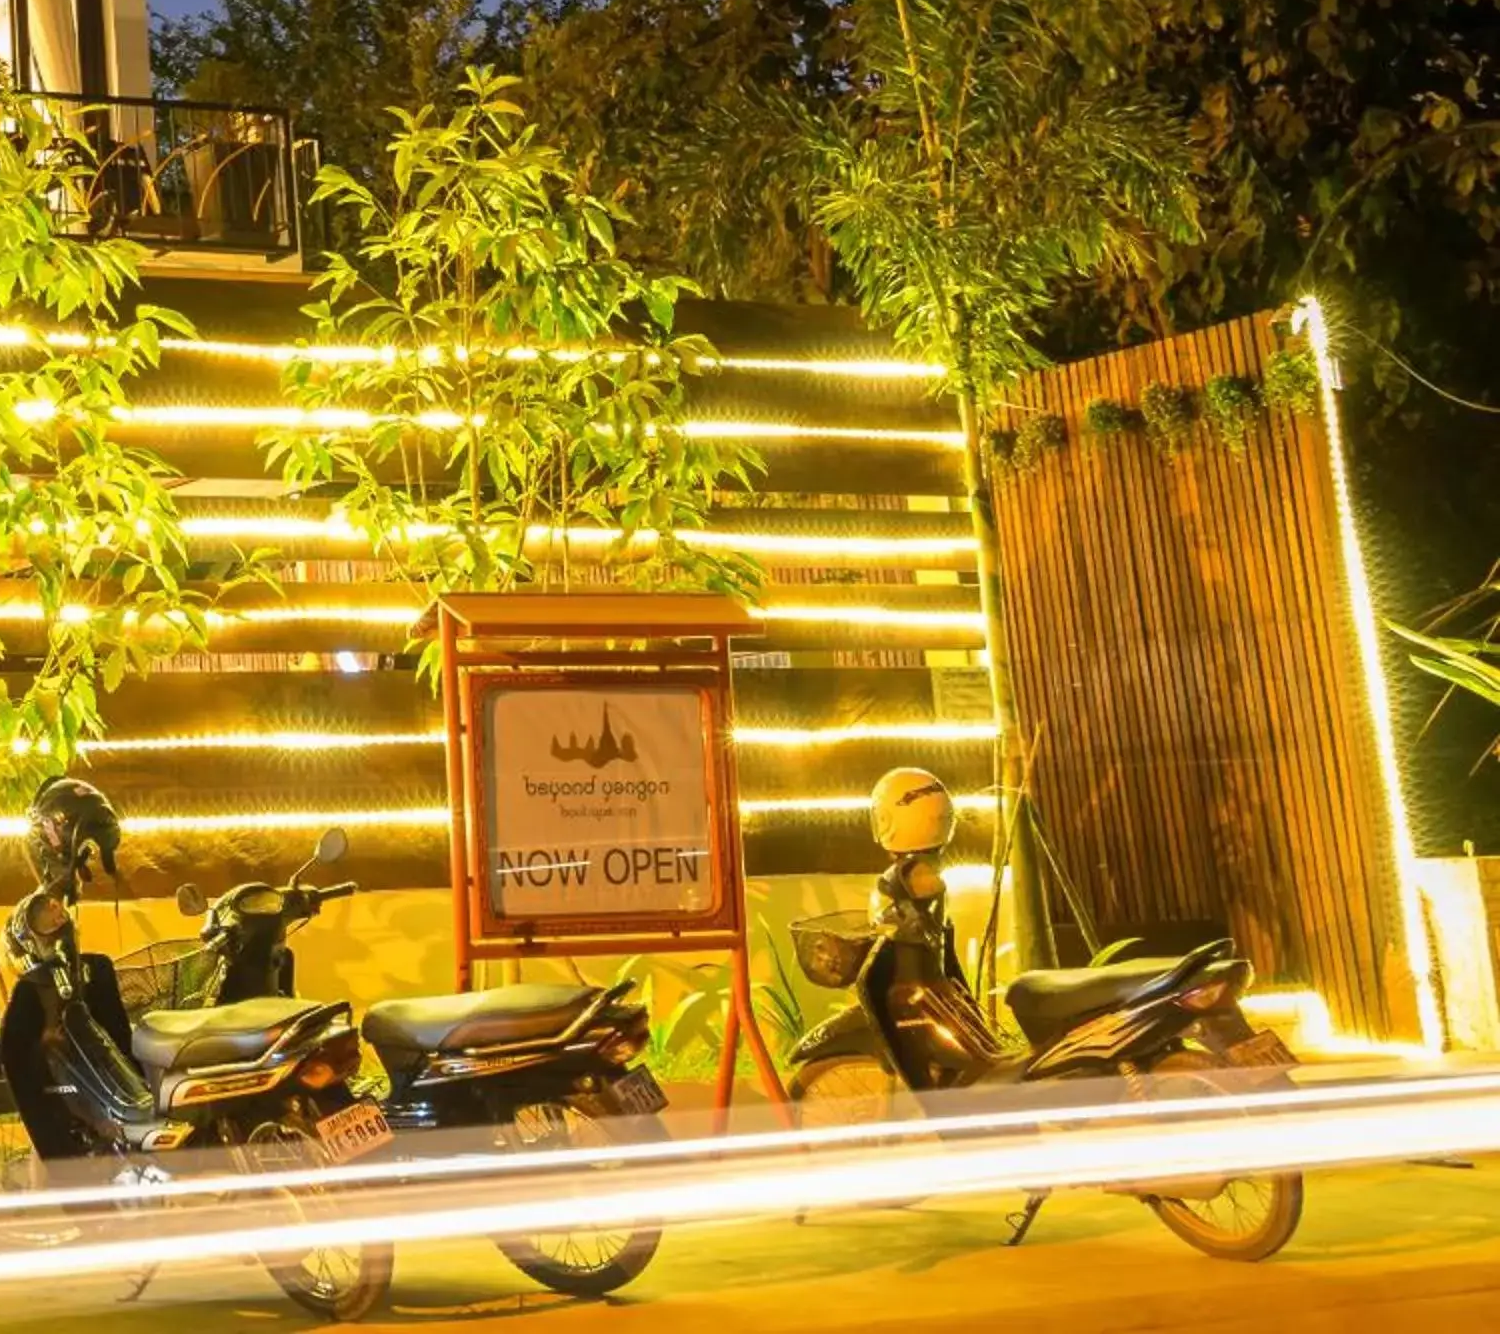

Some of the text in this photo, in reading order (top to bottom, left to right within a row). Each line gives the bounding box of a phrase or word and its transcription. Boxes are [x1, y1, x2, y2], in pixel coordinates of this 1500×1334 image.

[522, 775, 597, 804] beyond
[500, 847, 699, 887] NOW OPEN
